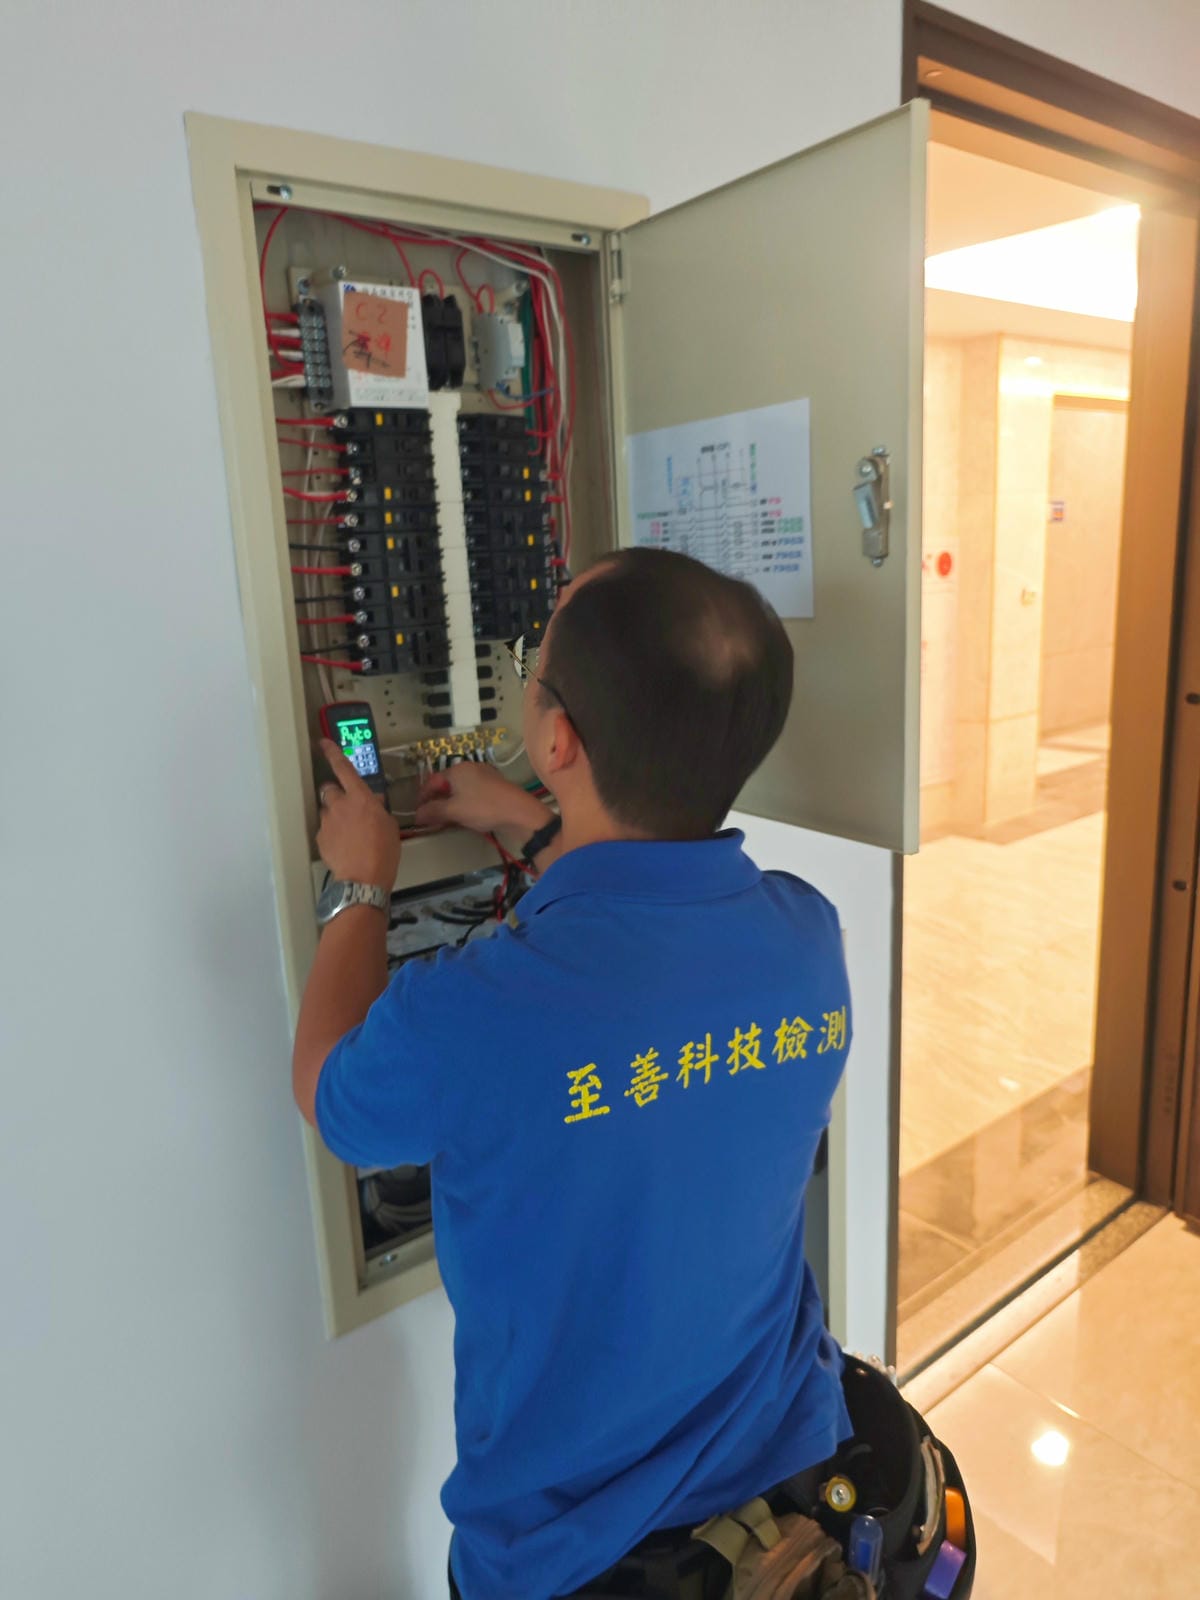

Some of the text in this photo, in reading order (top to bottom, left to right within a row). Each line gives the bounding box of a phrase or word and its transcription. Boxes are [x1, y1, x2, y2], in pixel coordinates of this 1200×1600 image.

[564, 1005, 847, 1123] 至善科技檢測
